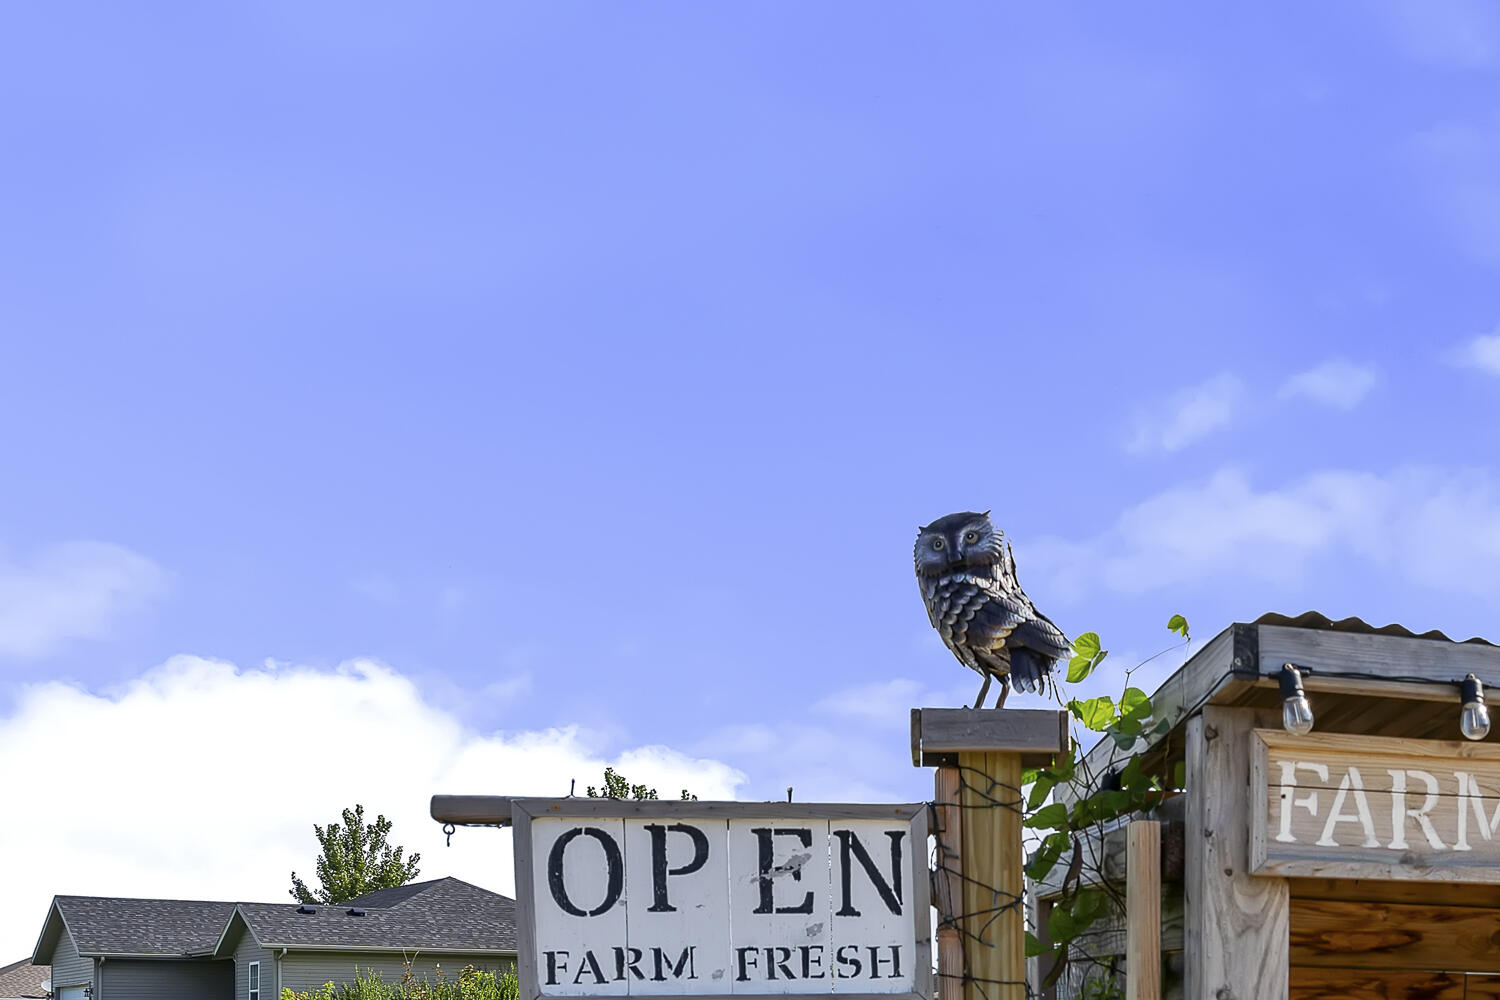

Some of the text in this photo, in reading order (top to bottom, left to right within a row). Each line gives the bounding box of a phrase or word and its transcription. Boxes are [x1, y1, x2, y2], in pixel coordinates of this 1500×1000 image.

[547, 822, 907, 917] OPEN
[543, 945, 905, 986] FARM FRESH
